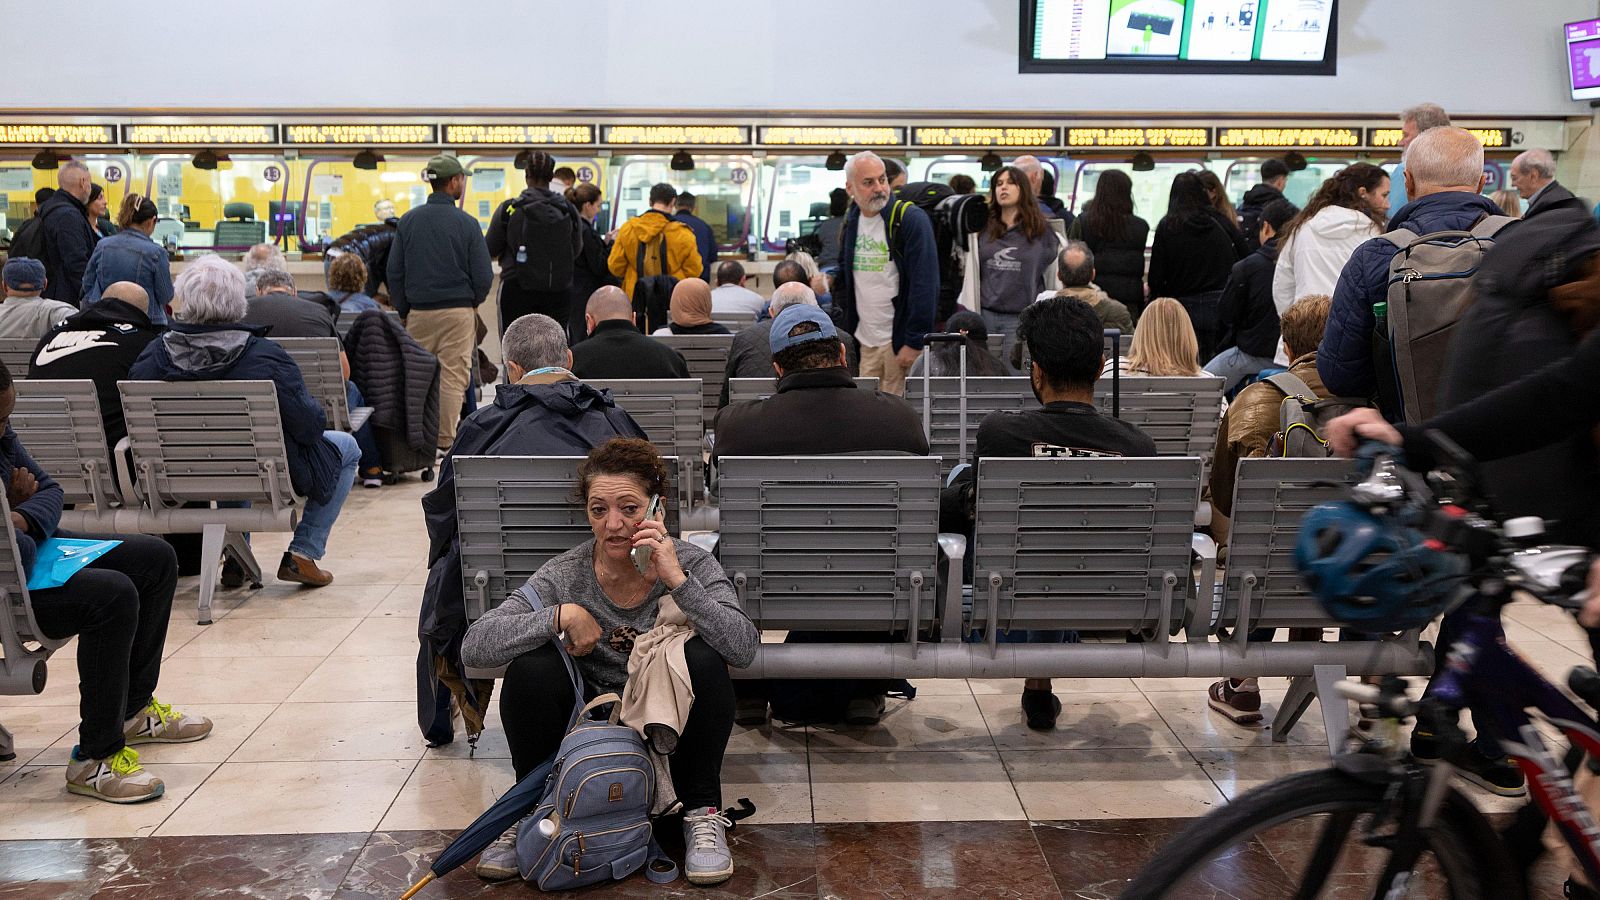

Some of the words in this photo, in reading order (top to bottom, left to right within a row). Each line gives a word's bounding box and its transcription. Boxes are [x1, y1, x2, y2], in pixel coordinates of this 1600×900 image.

[106, 169, 120, 179] 12
[266, 169, 279, 180] 13
[579, 169, 592, 180] 15
[733, 170, 746, 181] 16
